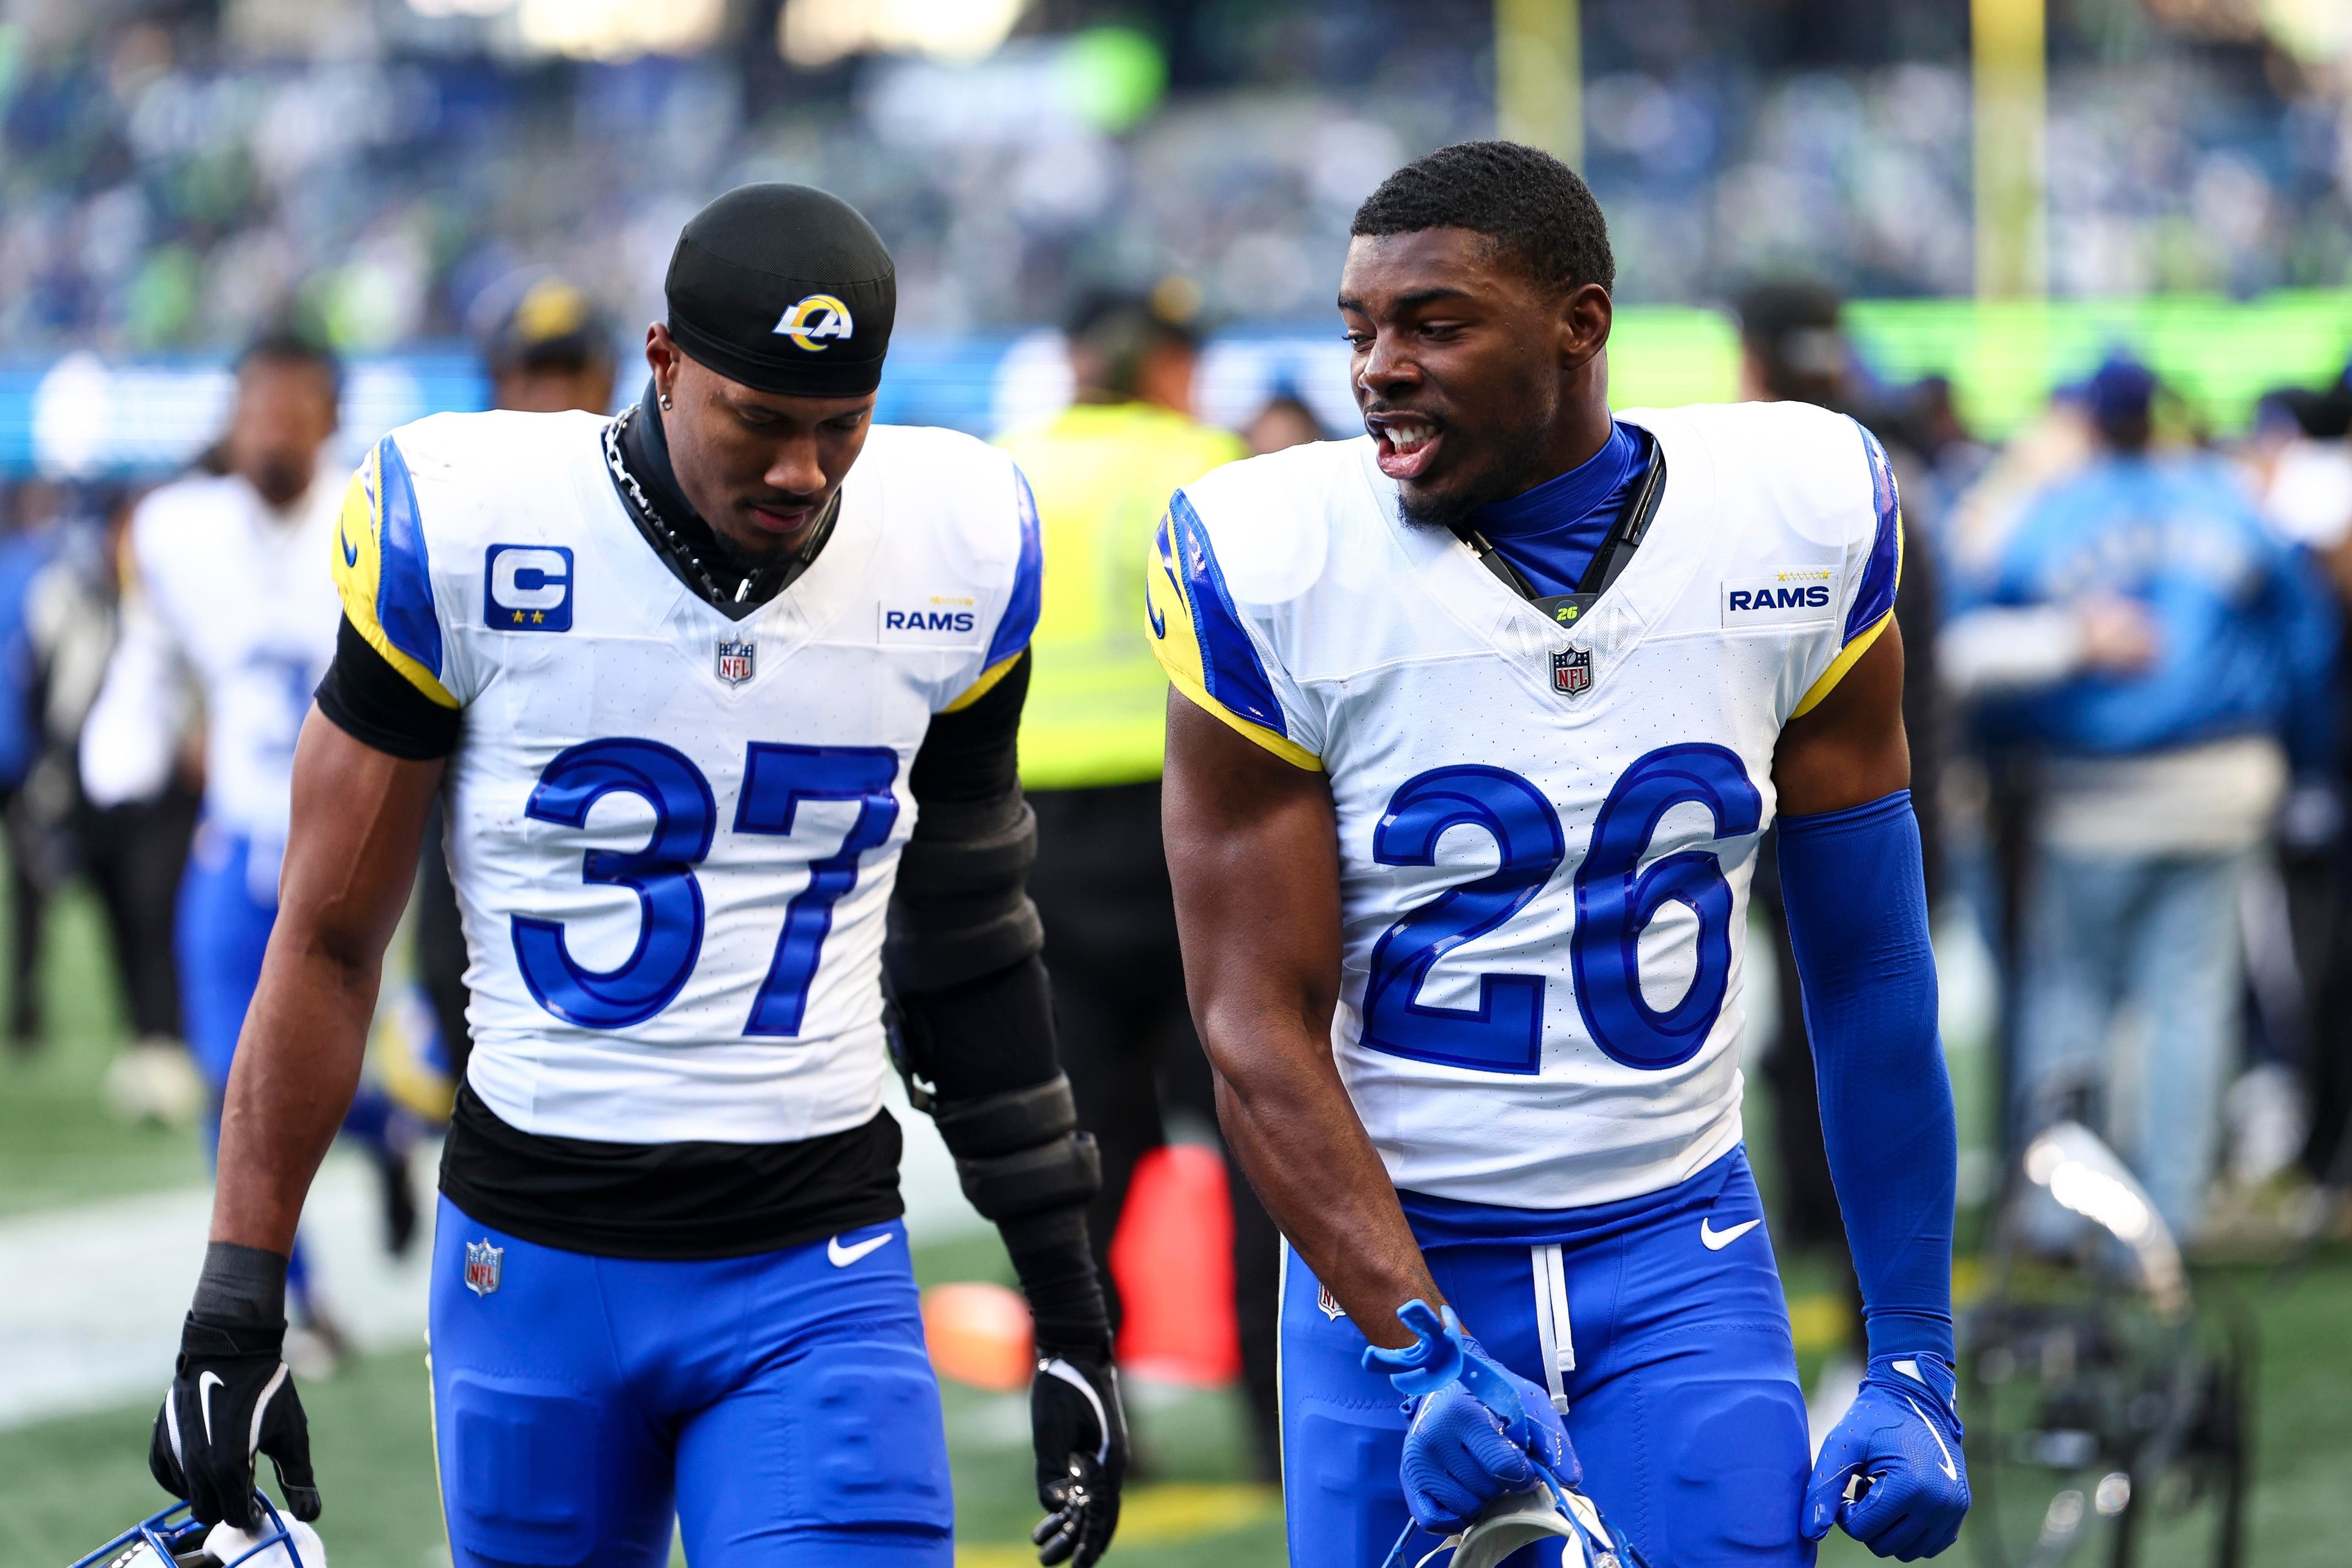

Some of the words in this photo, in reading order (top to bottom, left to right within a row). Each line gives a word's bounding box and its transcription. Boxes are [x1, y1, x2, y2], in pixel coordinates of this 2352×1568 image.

[772, 293, 854, 352] LA
[492, 548, 567, 609] C
[1730, 586, 1830, 611] RAMS
[886, 611, 974, 631] RAMS
[1556, 606, 1578, 621] 26
[722, 658, 749, 678] NFL
[1557, 667, 1588, 690] NFL
[510, 736, 899, 1036] 37
[1358, 742, 1762, 1076] 26
[470, 1264, 494, 1286] NFL
